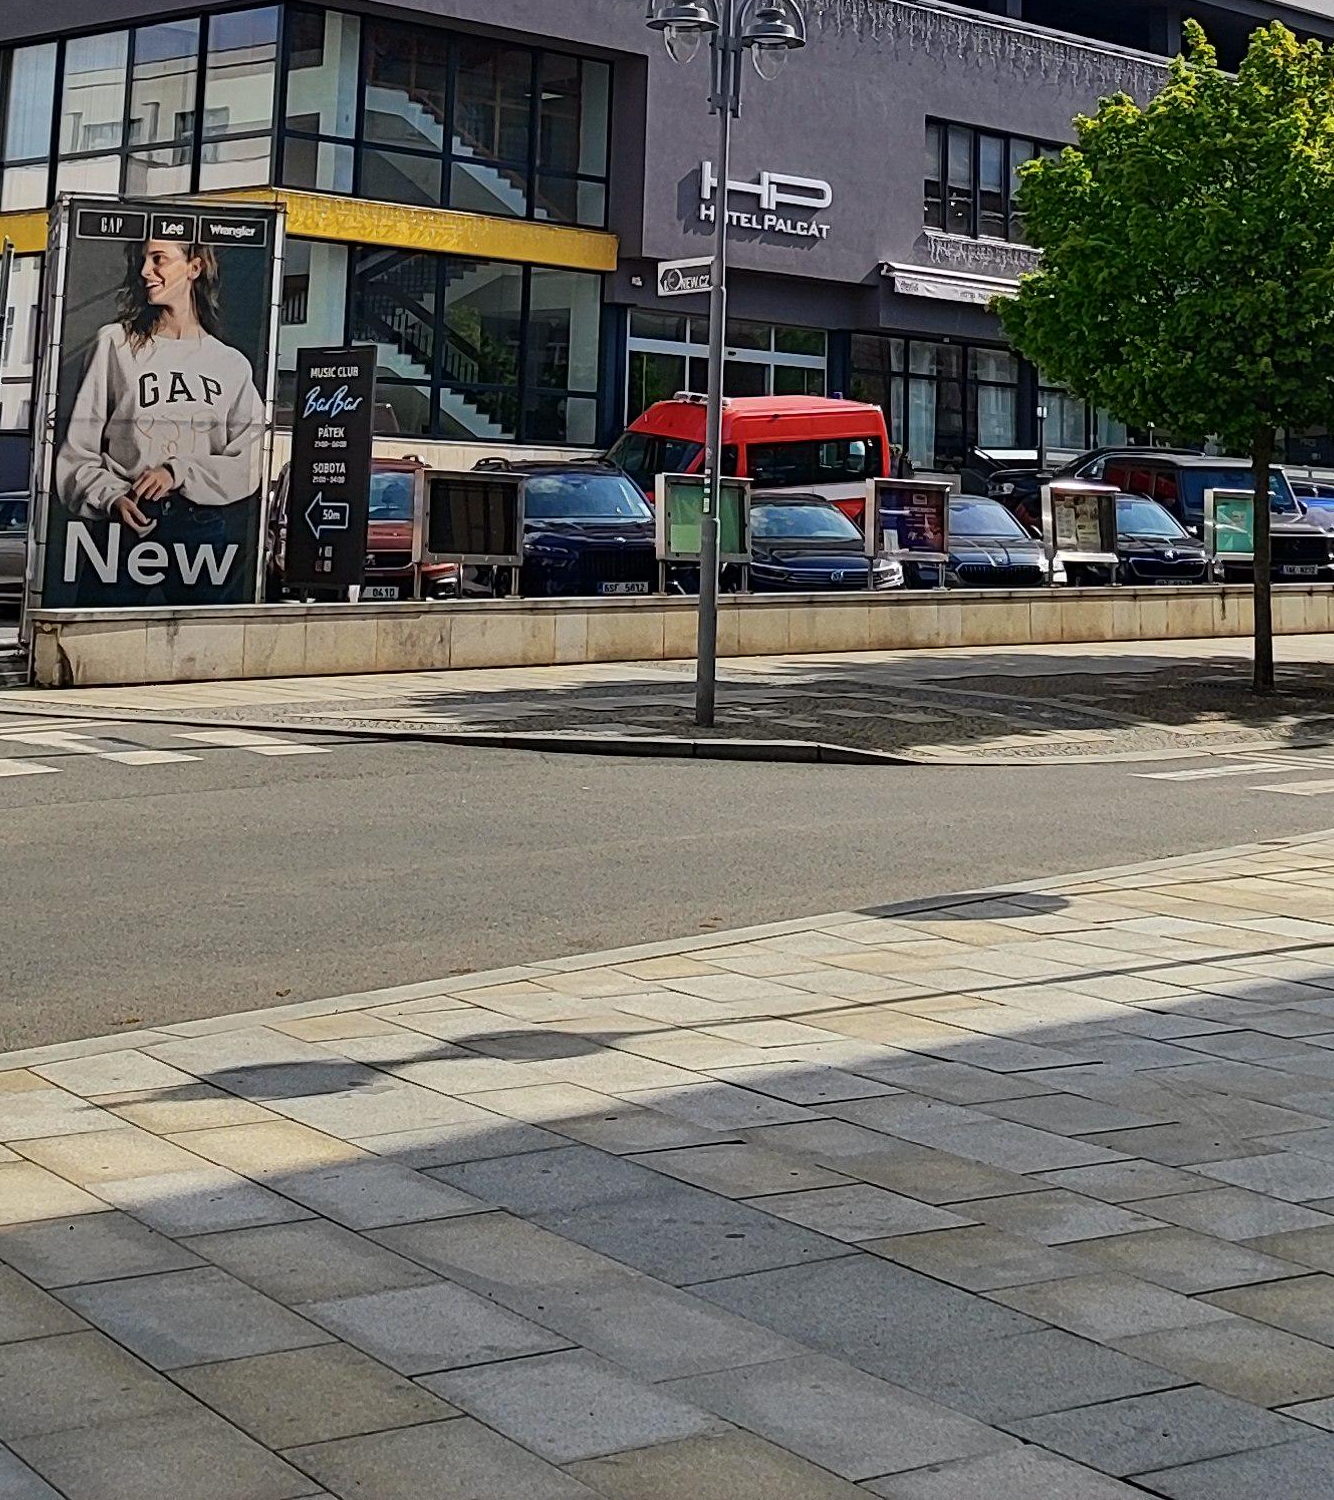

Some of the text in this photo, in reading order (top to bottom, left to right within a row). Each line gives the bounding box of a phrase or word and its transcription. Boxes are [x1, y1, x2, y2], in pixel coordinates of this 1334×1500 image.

[700, 204, 761, 230] HTEL
[101, 217, 123, 234] GAP
[161, 222, 185, 235] Lee
[209, 224, 255, 238] Wrangler
[310, 366, 359, 378] MUSIC CLUB
[139, 371, 222, 408] GAP
[302, 385, 364, 418] BarBar
[318, 425, 345, 438] PÁTEK
[312, 462, 346, 474] SOBOTA
[322, 509, 340, 520] 50m
[63, 521, 238, 586] New
